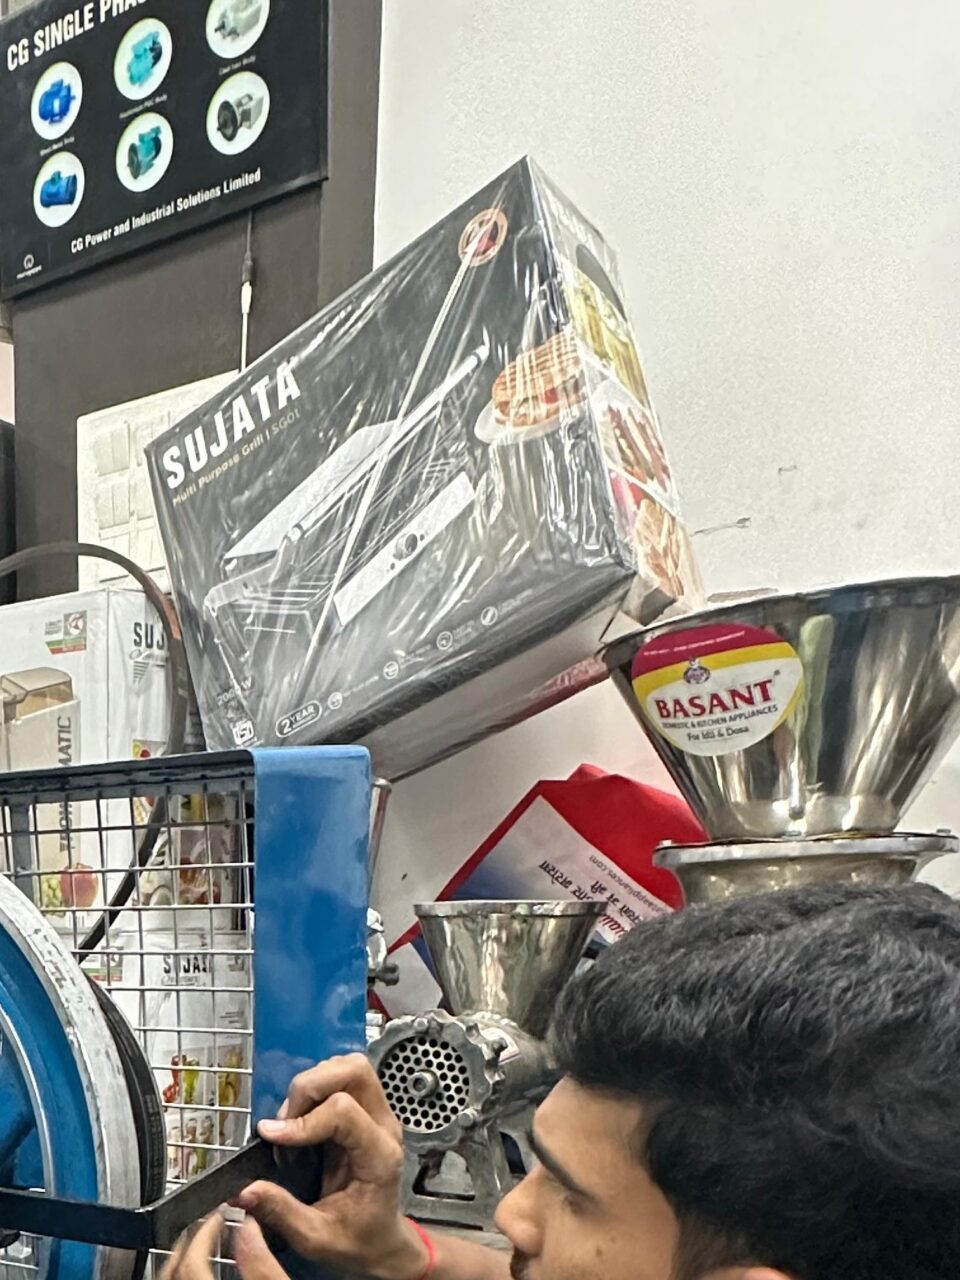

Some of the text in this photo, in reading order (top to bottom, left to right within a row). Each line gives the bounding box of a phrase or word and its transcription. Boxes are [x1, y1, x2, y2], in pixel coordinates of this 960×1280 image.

[7, 38, 29, 71] CG
[33, 3, 94, 57] SINGLE
[71, 167, 261, 253] CG Power and Industrial Solutions Limited
[163, 361, 301, 489] SUJATA
[172, 485, 197, 507] Multi
[198, 453, 240, 489] Purpose
[241, 434, 264, 456] Grill
[281, 705, 315, 734] 2 YEAR
[654, 678, 773, 719] BASANT
[697, 717, 728, 728] KITCHEN
[729, 704, 778, 722] APPLIANCES
